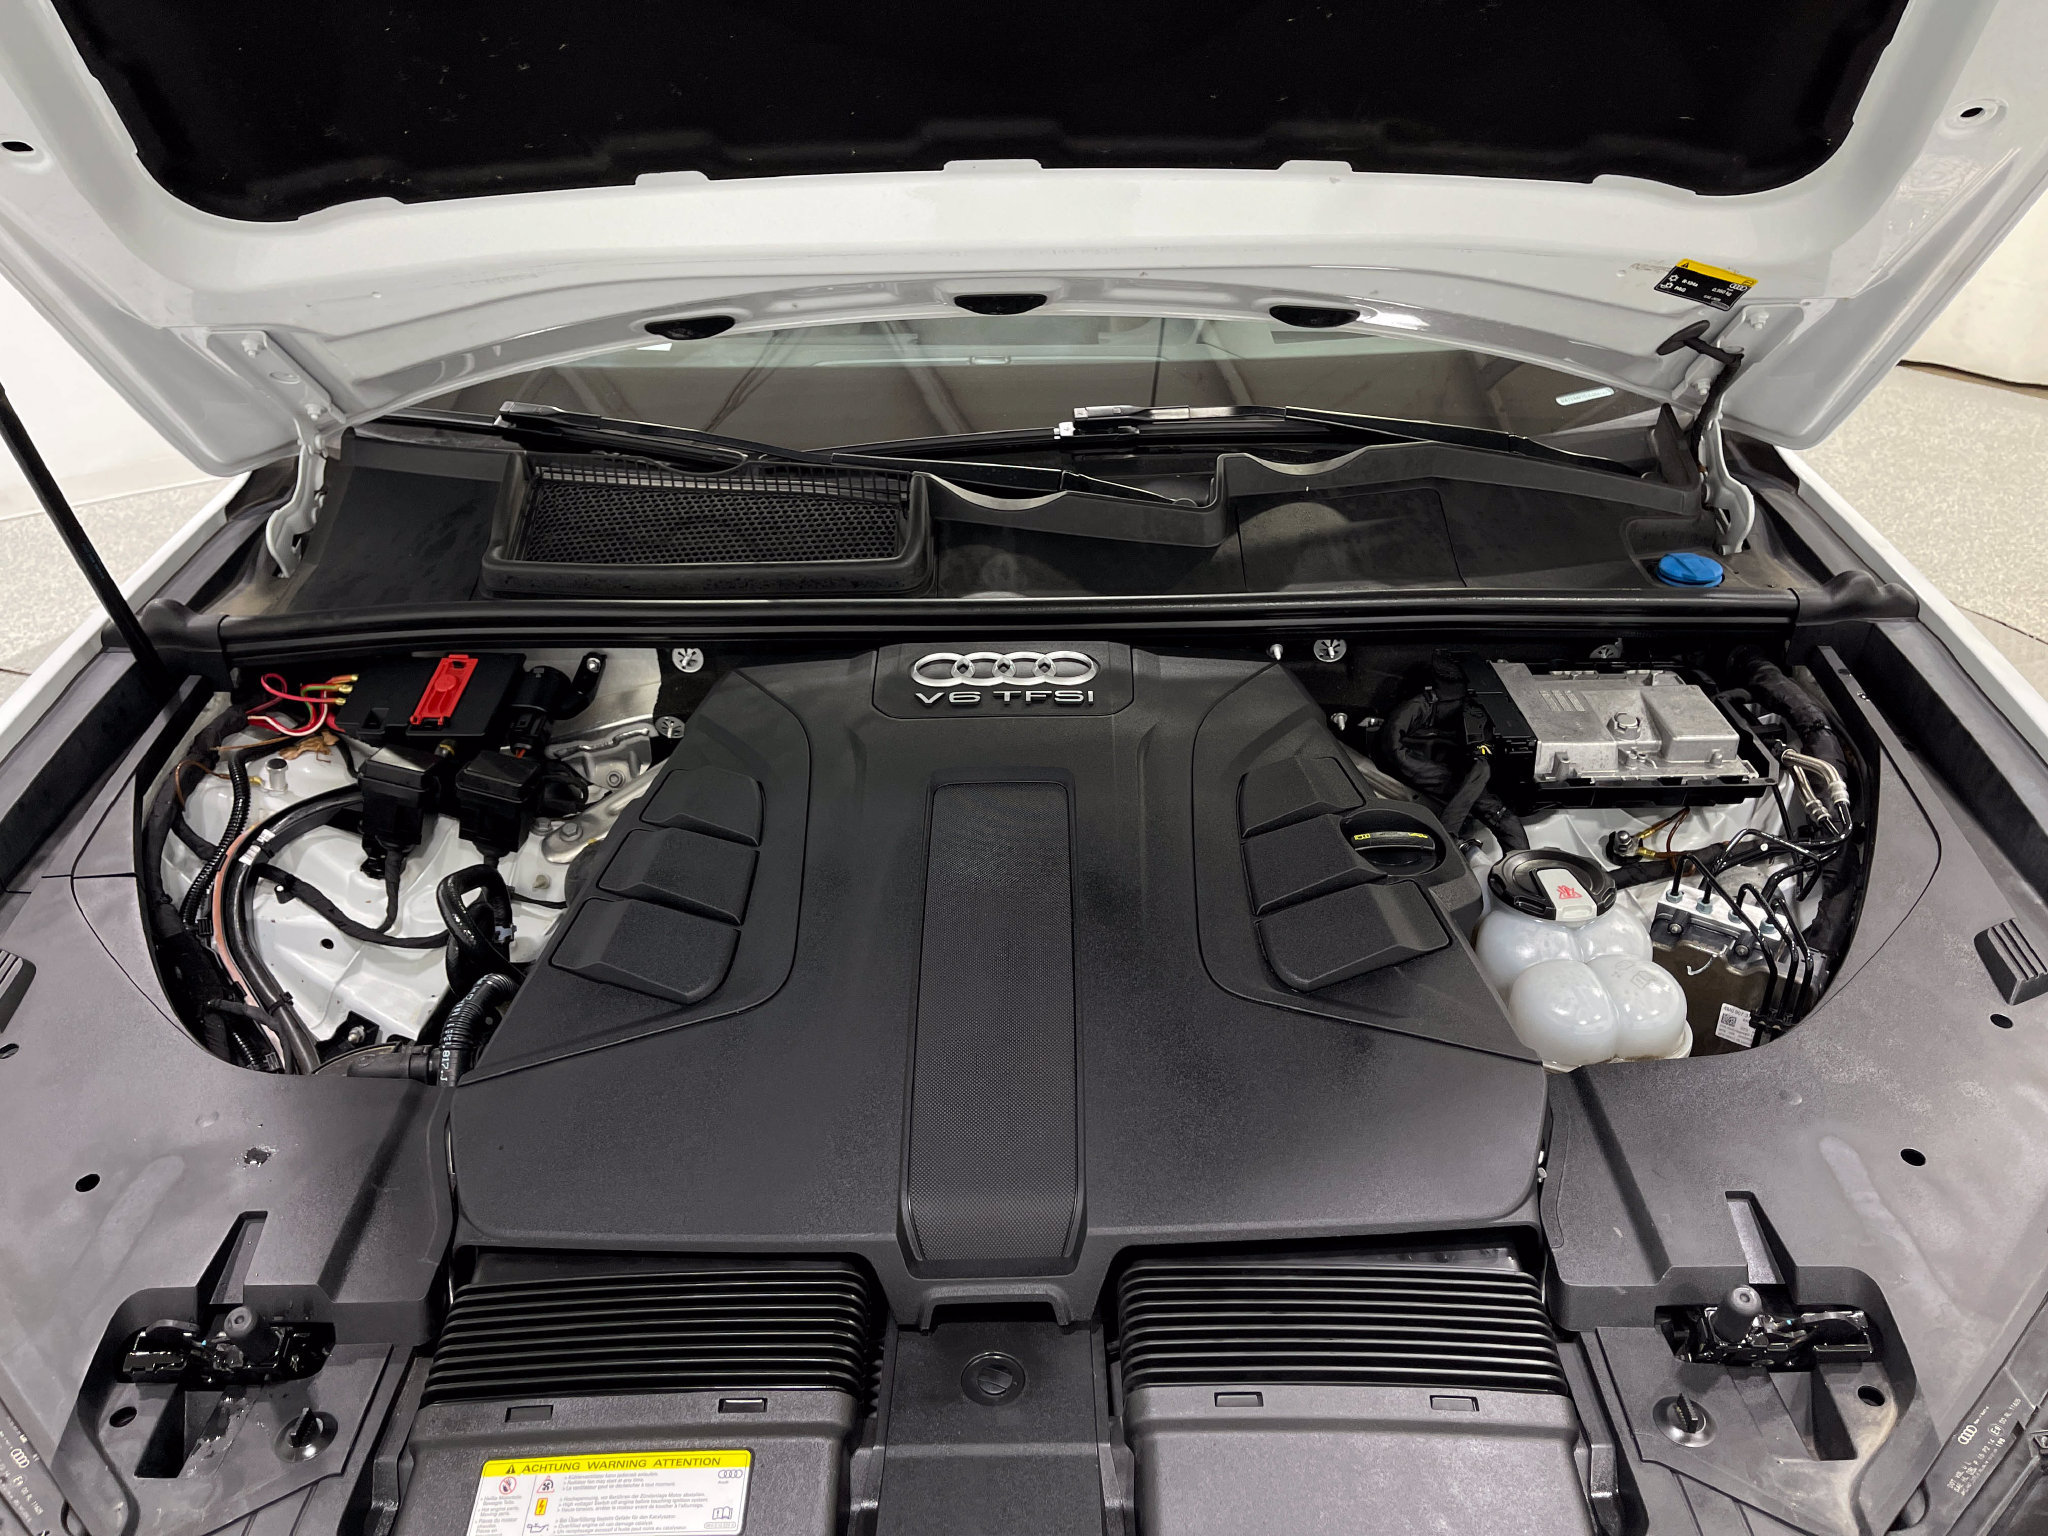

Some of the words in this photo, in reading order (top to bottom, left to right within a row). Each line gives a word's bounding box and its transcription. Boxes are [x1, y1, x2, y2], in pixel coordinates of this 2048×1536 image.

[915, 691, 982, 704] V6
[993, 690, 1094, 704] TFSI
[522, 1462, 580, 1473] ACHTUNG
[587, 1459, 647, 1470] WARNING
[654, 1458, 721, 1467] ATTENTION
